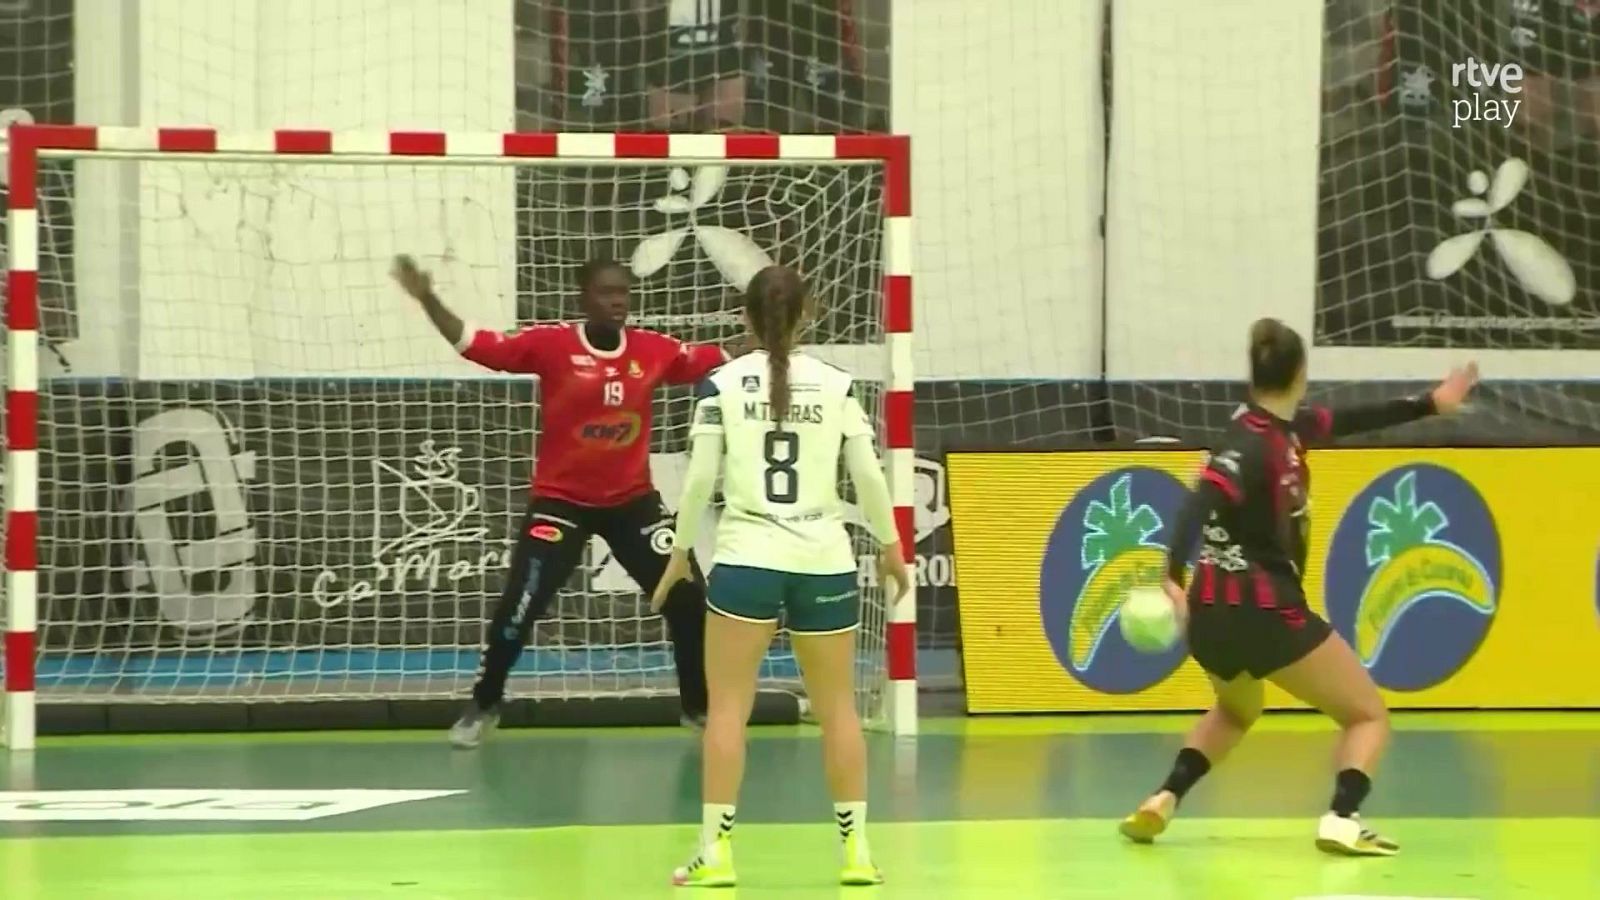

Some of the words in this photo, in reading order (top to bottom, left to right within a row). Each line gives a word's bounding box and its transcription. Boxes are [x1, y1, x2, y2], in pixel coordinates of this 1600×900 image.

[603, 381, 624, 406] 19
[743, 401, 823, 424] M.TRAS
[764, 430, 798, 504] 8
